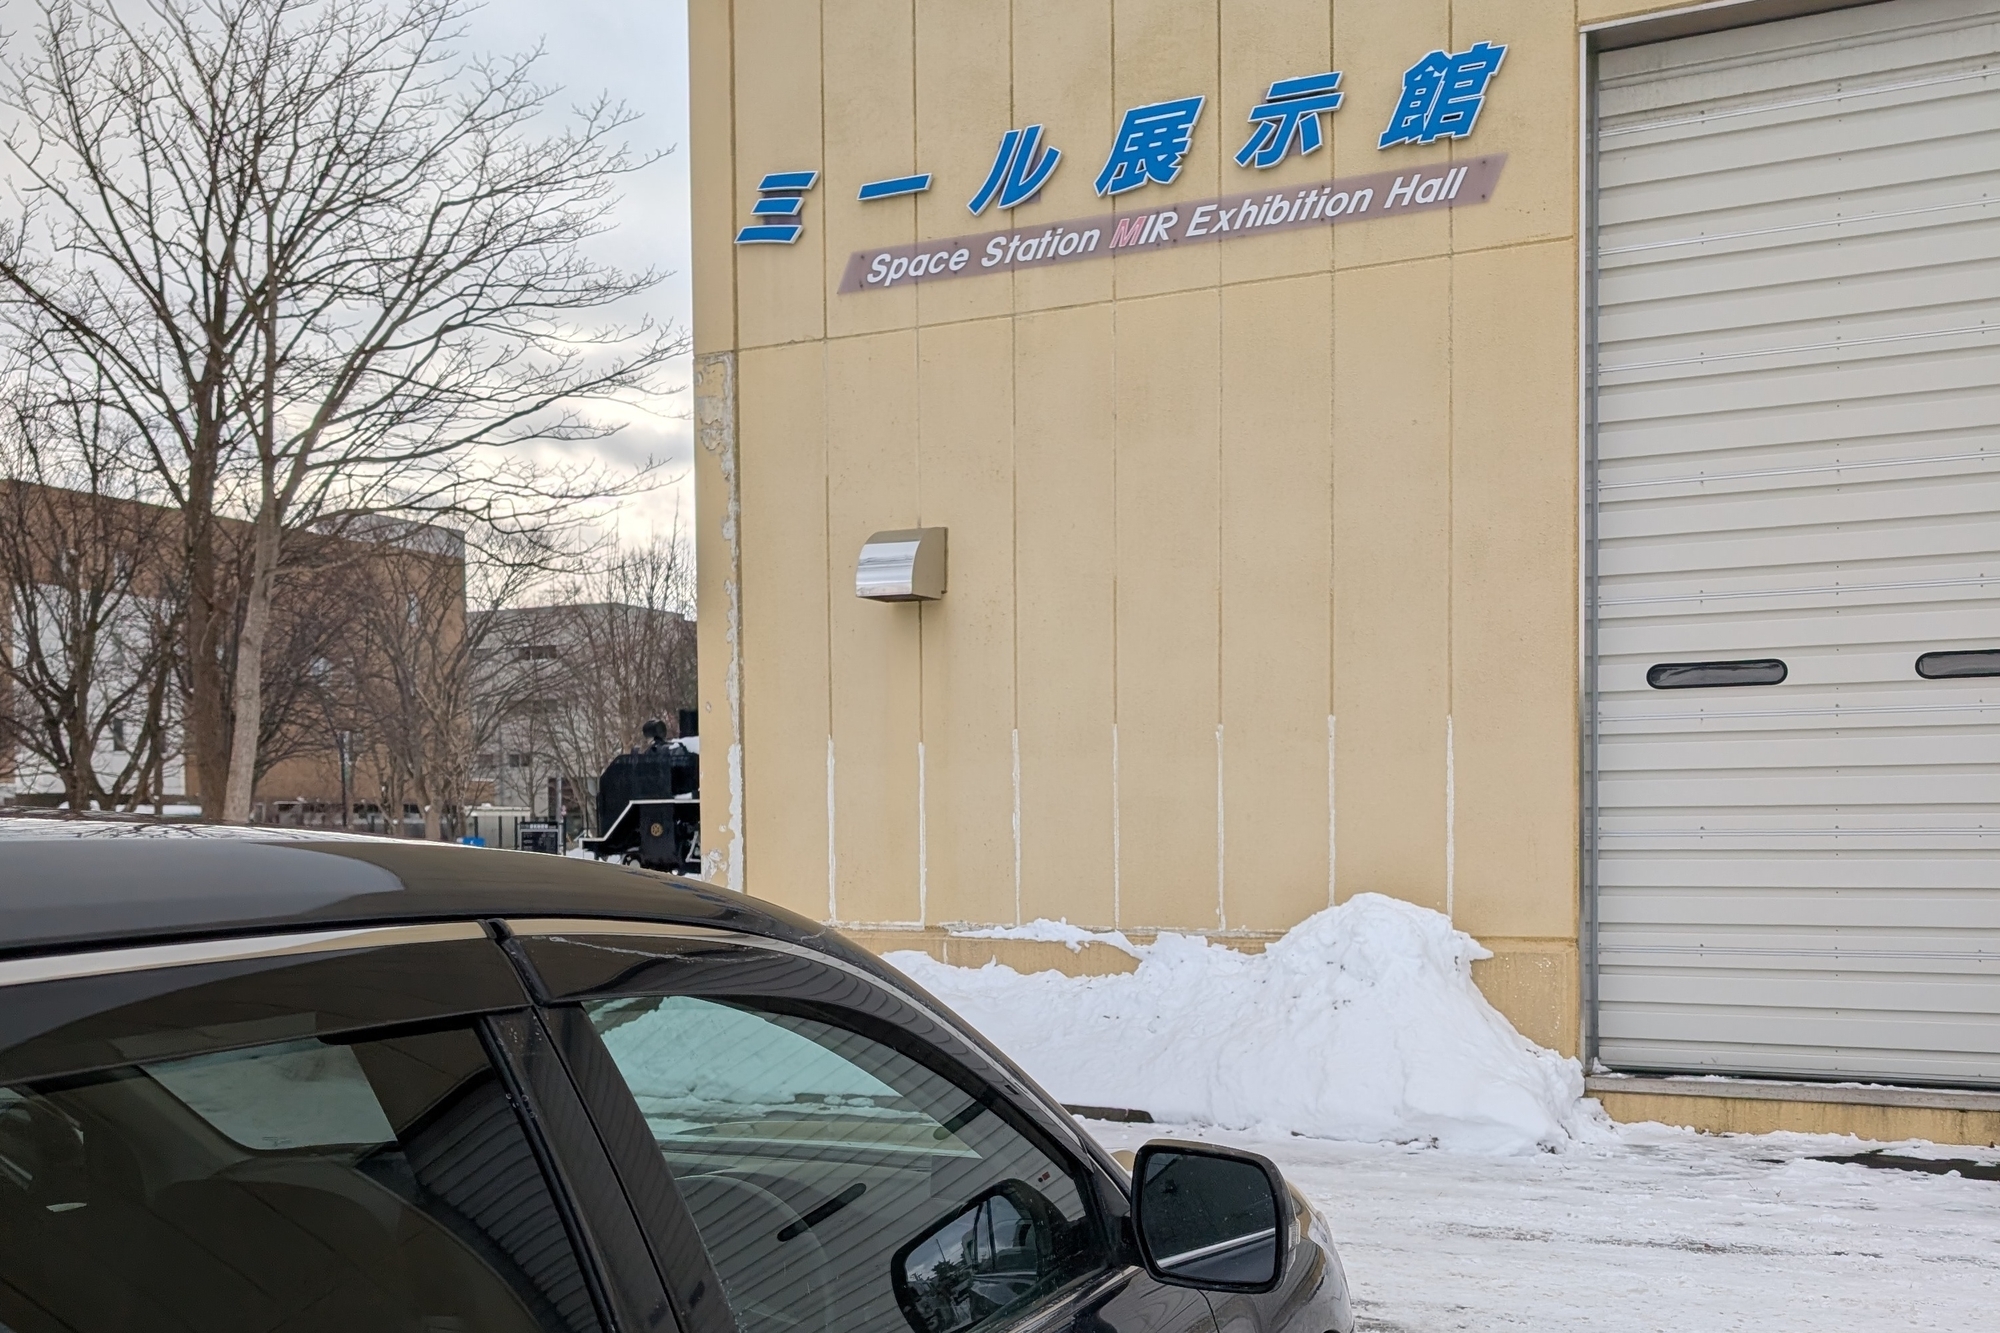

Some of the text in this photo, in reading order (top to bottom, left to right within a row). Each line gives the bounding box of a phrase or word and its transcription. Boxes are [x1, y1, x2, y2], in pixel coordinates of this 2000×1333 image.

[735, 41, 1507, 244] ミール展示館
[866, 166, 1469, 287] Space Station MIR Exhibition Hall
